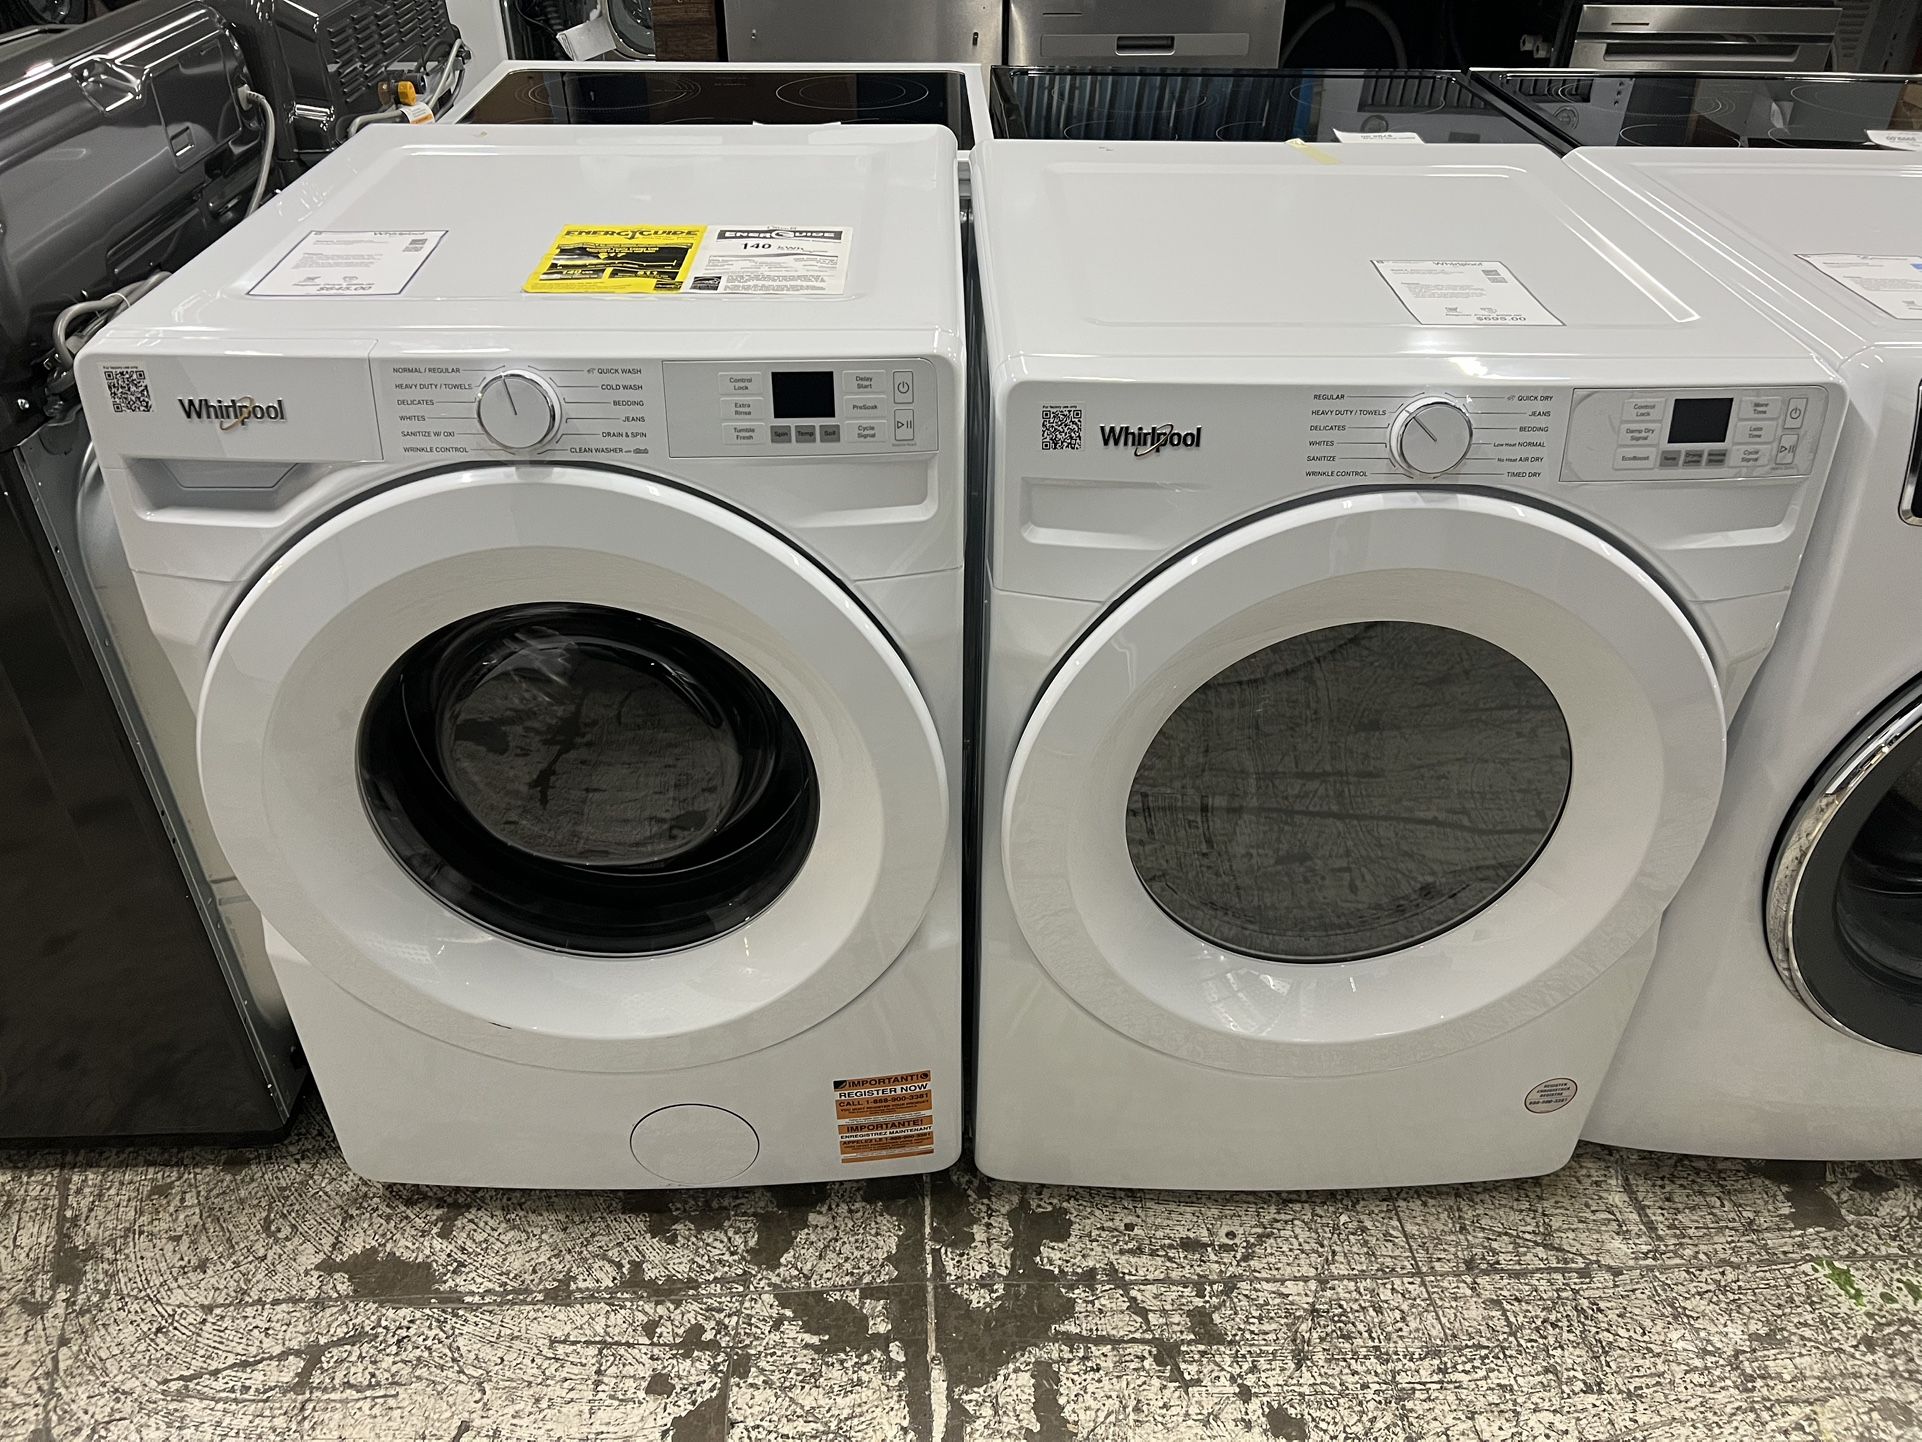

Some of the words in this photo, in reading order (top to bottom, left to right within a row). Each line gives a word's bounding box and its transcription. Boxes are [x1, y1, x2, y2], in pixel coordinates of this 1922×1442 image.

[743, 242, 772, 250] 140
[597, 367, 620, 375] QUICK
[600, 383, 621, 391] COLD
[178, 397, 287, 428] Whirlpool
[1099, 424, 1202, 454] Whirlpool
[848, 1074, 919, 1088] IMPORTANT!
[839, 1087, 897, 1099] REGISTER
[900, 1083, 928, 1094] NOW
[840, 1131, 888, 1140] ENREGISTREZ
[888, 1126, 933, 1135] MAINTENANT
[846, 1119, 923, 1133] IMPORTANTE!
